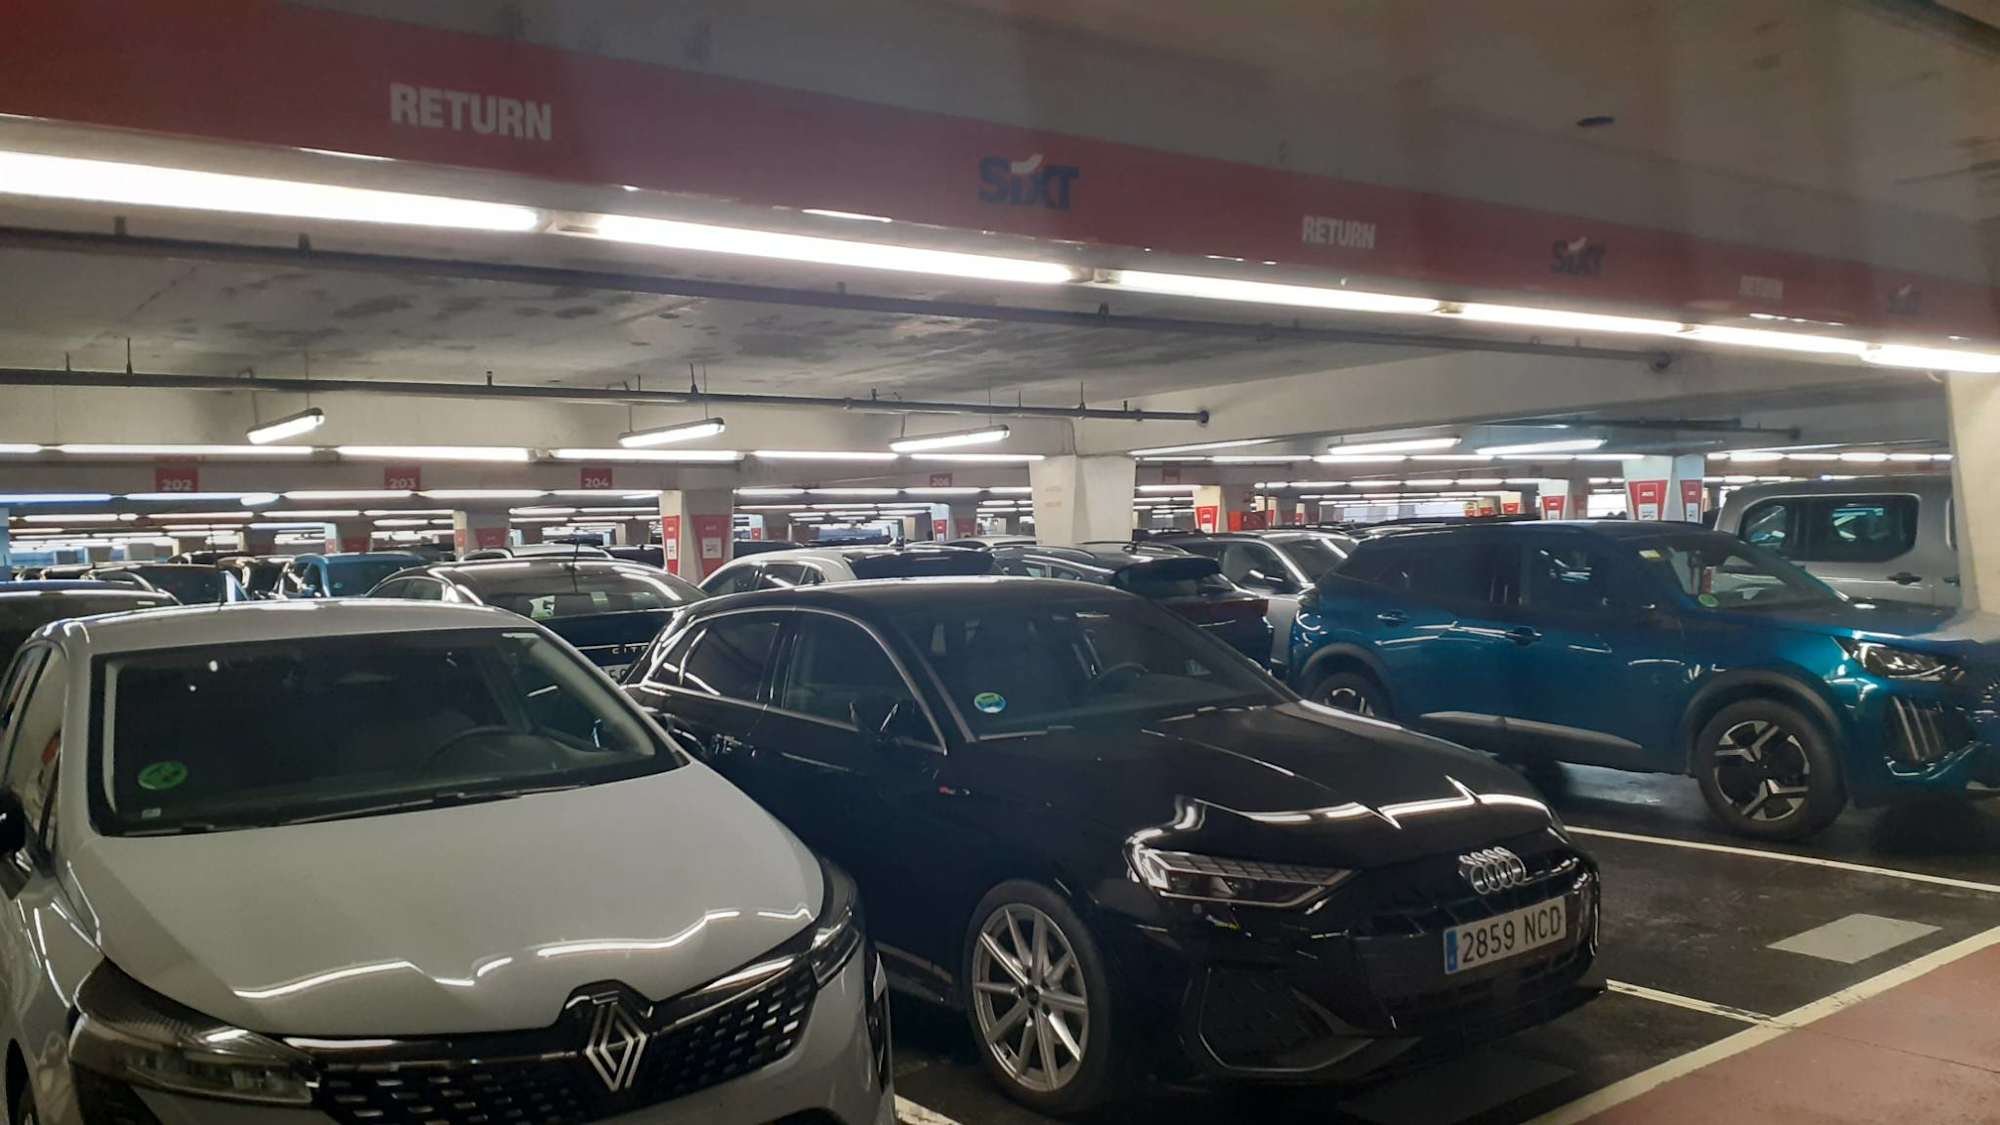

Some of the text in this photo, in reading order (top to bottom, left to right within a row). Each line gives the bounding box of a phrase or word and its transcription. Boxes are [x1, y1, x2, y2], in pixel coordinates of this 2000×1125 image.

[389, 82, 552, 141] RETURN
[978, 153, 1080, 210] SIXT
[1302, 215, 1377, 249] RETURN
[160, 479, 193, 492] 202
[389, 478, 417, 490] 203
[583, 478, 609, 489] 204
[1461, 905, 1562, 964] 2859 NCD
